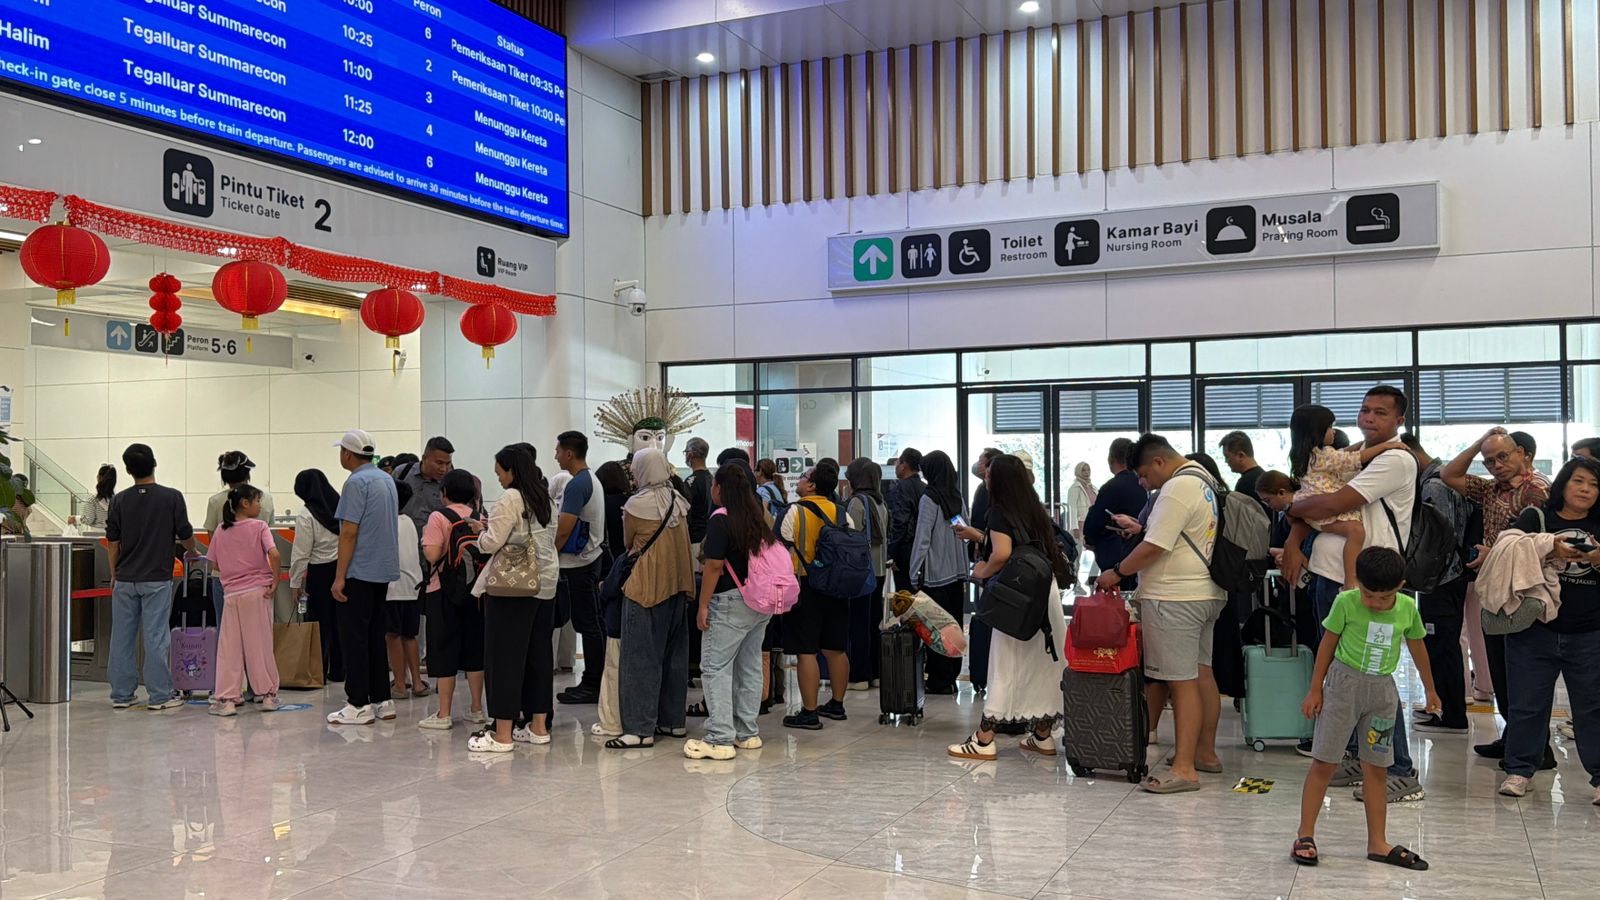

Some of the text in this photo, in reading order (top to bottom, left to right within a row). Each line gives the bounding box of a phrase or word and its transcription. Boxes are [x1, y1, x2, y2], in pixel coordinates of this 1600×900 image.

[342, 0, 373, 13] :00
[0, 19, 49, 50] Halim
[198, 5, 286, 49] Summarecon
[342, 24, 374, 48] 10:25
[424, 26, 432, 39] 6
[123, 17, 286, 86] Tegalluar Summarecon
[497, 35, 525, 57] Status
[342, 59, 373, 81] 11:00
[425, 60, 433, 72] 2
[451, 39, 507, 74] Pemeriksaan
[508, 64, 529, 83] Tiket
[530, 74, 554, 94] 09:35
[123, 59, 286, 123] Tegalluar Summarecon
[425, 92, 433, 104] 3
[452, 70, 508, 103] Pemeriksaan
[509, 94, 530, 113] Tiket
[531, 104, 554, 122] 10:00
[343, 94, 373, 115] 11:25
[342, 128, 374, 150] 12:00
[425, 124, 433, 136] 4
[474, 110, 548, 148] Menunggu Kereta
[51, 73, 81, 92] gate
[84, 82, 116, 102] close
[119, 92, 127, 104] 5
[130, 96, 177, 118] minutes
[180, 109, 216, 129] before
[218, 120, 243, 138] train
[244, 129, 295, 152] departure.
[297, 142, 347, 168] Passengers
[348, 161, 362, 172] are
[363, 163, 394, 180] advised
[395, 172, 404, 183] to
[406, 177, 428, 191] arrive
[429, 182, 439, 193] 30
[440, 186, 468, 201] minutes
[469, 193, 491, 208] before
[492, 200, 503, 212] the
[504, 205, 518, 217] train
[520, 209, 549, 226] departure
[475, 141, 548, 177] Menunggu Kereta
[426, 156, 433, 168] 6
[221, 175, 305, 209] Pintu Tiket
[475, 171, 548, 205] Menunggu Kereta
[220, 196, 281, 219] Ticket Gate
[314, 199, 332, 232] 2
[1262, 210, 1322, 227] Musala
[1107, 219, 1199, 240] Kamar Bayi
[1262, 228, 1338, 242] Praying Room
[1001, 235, 1043, 250] Toilet
[1106, 238, 1182, 252] Nursing Room
[497, 257, 528, 272] Ruang VIP
[1000, 250, 1048, 262] Restroom
[187, 334, 209, 345] Peron
[1374, 634, 1385, 643] 23
